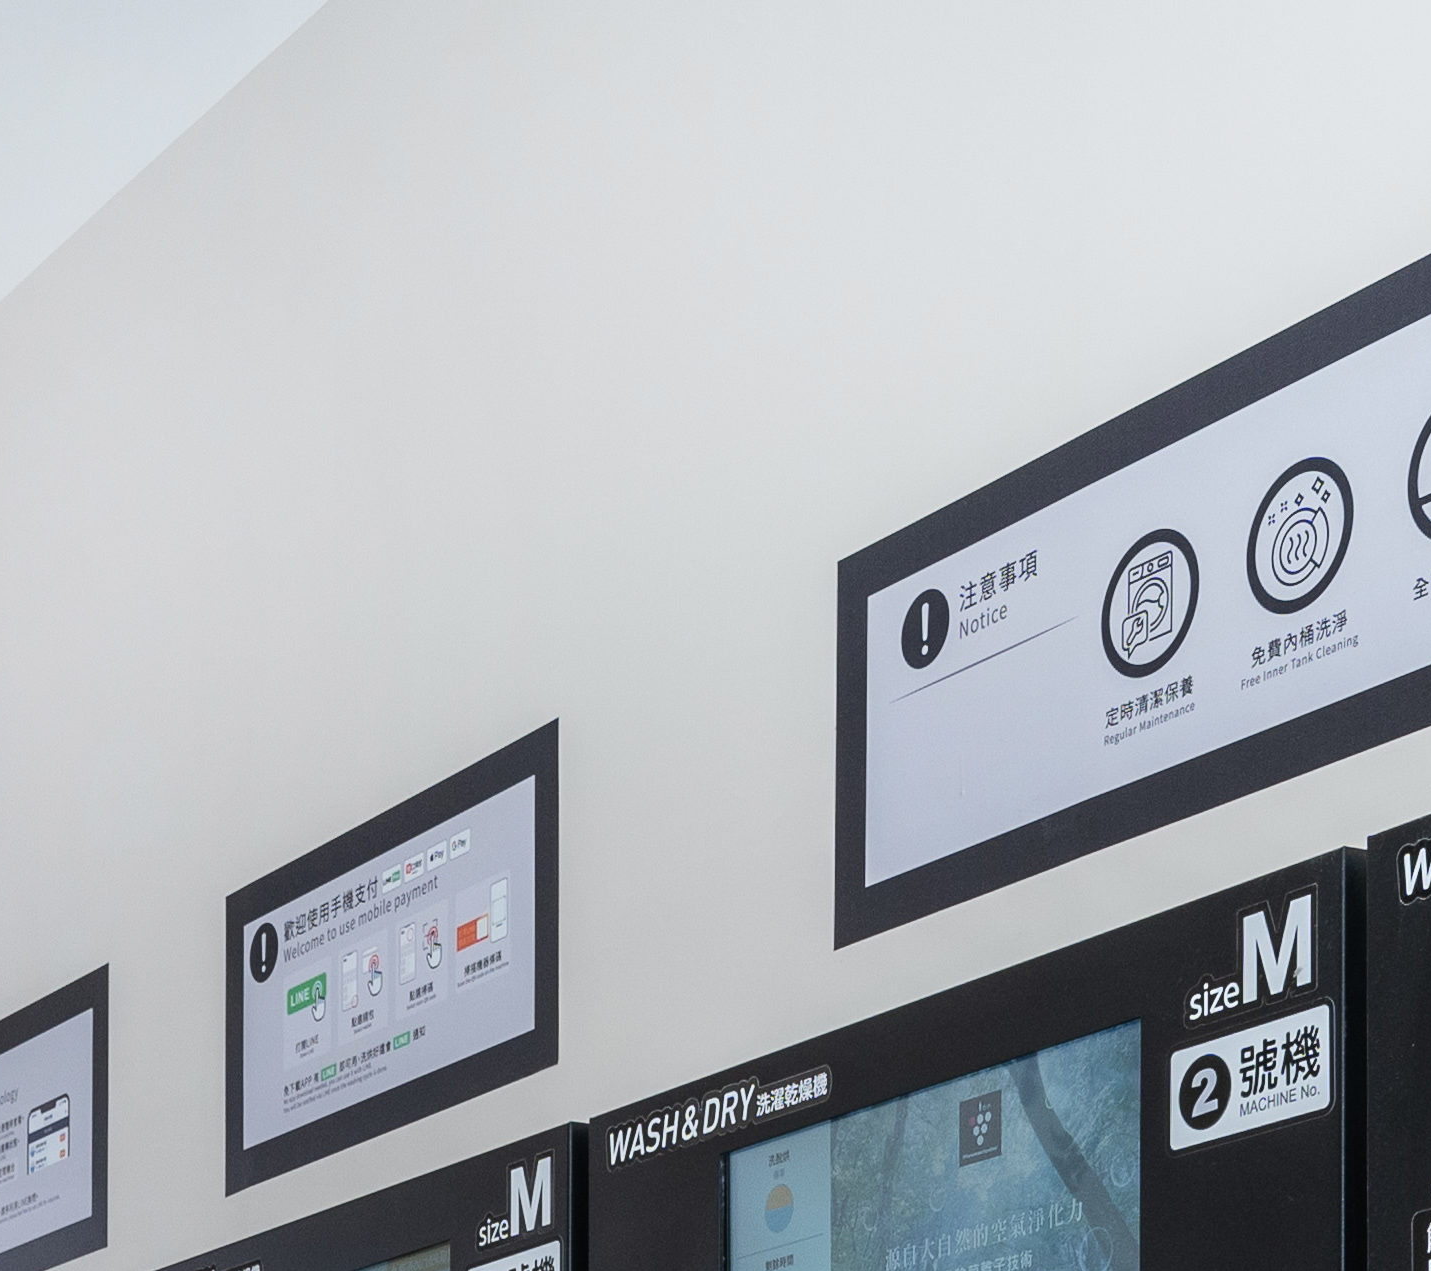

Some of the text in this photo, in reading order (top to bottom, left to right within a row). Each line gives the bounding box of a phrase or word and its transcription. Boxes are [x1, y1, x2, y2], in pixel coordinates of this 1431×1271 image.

[958, 549, 1039, 612] 注意事項
[958, 602, 1009, 639] Notice
[1250, 610, 1348, 669] 免費內桶洗淨
[1240, 633, 1360, 691] Free Inner Tank Cleaning
[1103, 700, 1196, 748] Regular Maintenance
[283, 876, 378, 943] 歡迎使用手機支付
[283, 875, 438, 963] Welcome to use mobile payment
[1189, 894, 1312, 1020] size M
[290, 989, 310, 1008] LINE
[394, 1033, 410, 1048] LINE
[1191, 1025, 1320, 1118] 2 號機
[1240, 1085, 1320, 1117] MACHINE No.
[479, 1156, 551, 1247] size M
[885, 1198, 1083, 1271] 源自大自然的空氣淨化力
